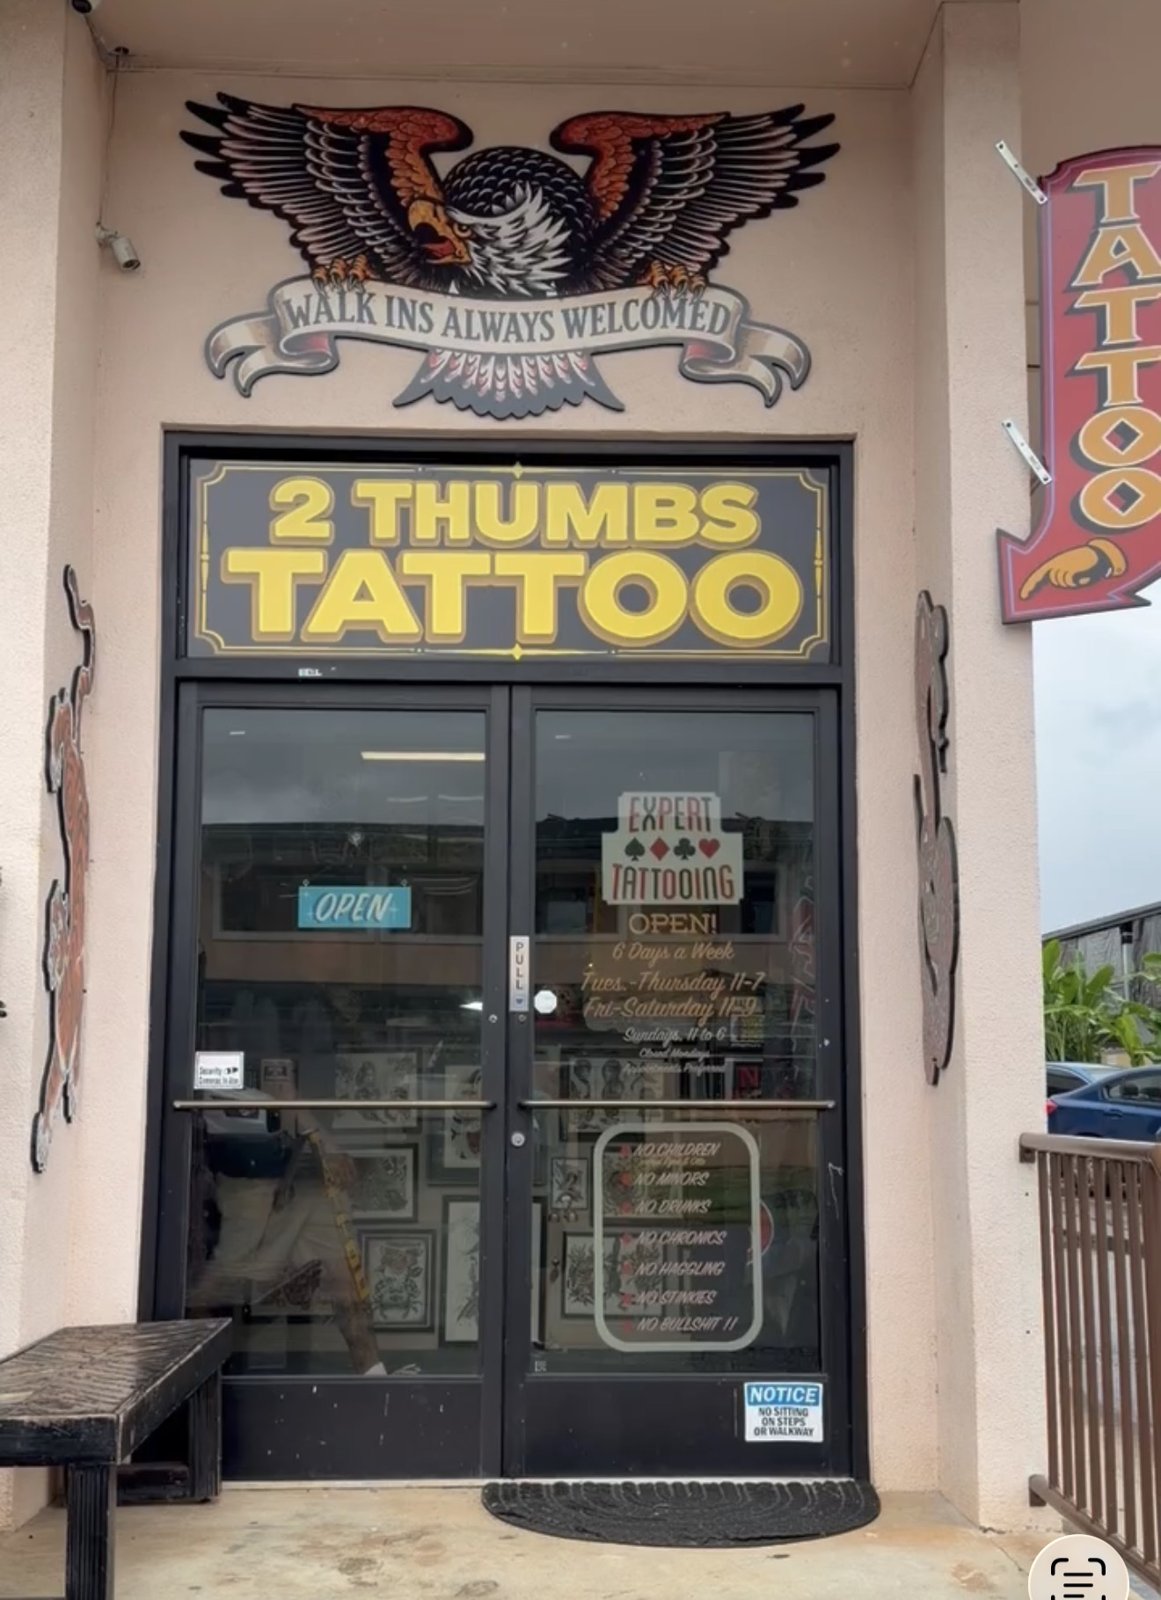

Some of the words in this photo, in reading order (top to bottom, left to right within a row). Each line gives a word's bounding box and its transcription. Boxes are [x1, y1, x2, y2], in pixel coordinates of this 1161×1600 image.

[284, 286, 377, 329] WALK
[384, 294, 434, 335] INS
[440, 304, 556, 345] ALWAYS
[560, 295, 732, 340] WELCOMED
[1070, 160, 1161, 531] TATTOO
[269, 477, 335, 547] 2
[350, 479, 762, 552] THUMBS
[221, 548, 804, 648] TATTOO
[629, 797, 713, 833] EXPERT
[612, 863, 735, 901] TATTOOING
[315, 893, 394, 922] OPEN
[628, 913, 718, 935] OPEN!
[612, 943, 625, 960] 6
[628, 942, 671, 969] Days
[674, 948, 687, 960] a
[691, 941, 736, 961] Week
[515, 942, 525, 991] PULL
[584, 996, 714, 1027] Fri-Saturday
[700, 1027, 714, 1041] to
[716, 1026, 728, 1041] 6
[633, 1143, 655, 1156] NO
[656, 1142, 721, 1156] CHILDREN
[633, 1172, 656, 1186] NO
[656, 1171, 710, 1186] MINORS
[635, 1200, 657, 1214] NO
[658, 1199, 712, 1214] DRUNKS
[635, 1231, 657, 1245] NO
[657, 1231, 727, 1246] CHRONICS
[635, 1262, 658, 1276] NO
[658, 1261, 726, 1276] HAGGLING
[636, 1291, 659, 1304] NO
[637, 1317, 659, 1331] NO
[660, 1316, 722, 1331] BULLSHIT
[750, 1386, 818, 1403] NOTICE
[758, 1407, 772, 1417] NO
[773, 1407, 809, 1417] SITTING
[761, 1417, 775, 1426] ON
[776, 1417, 806, 1427] STEPS
[753, 1427, 767, 1437] OR
[768, 1427, 814, 1437] WALKWAY
